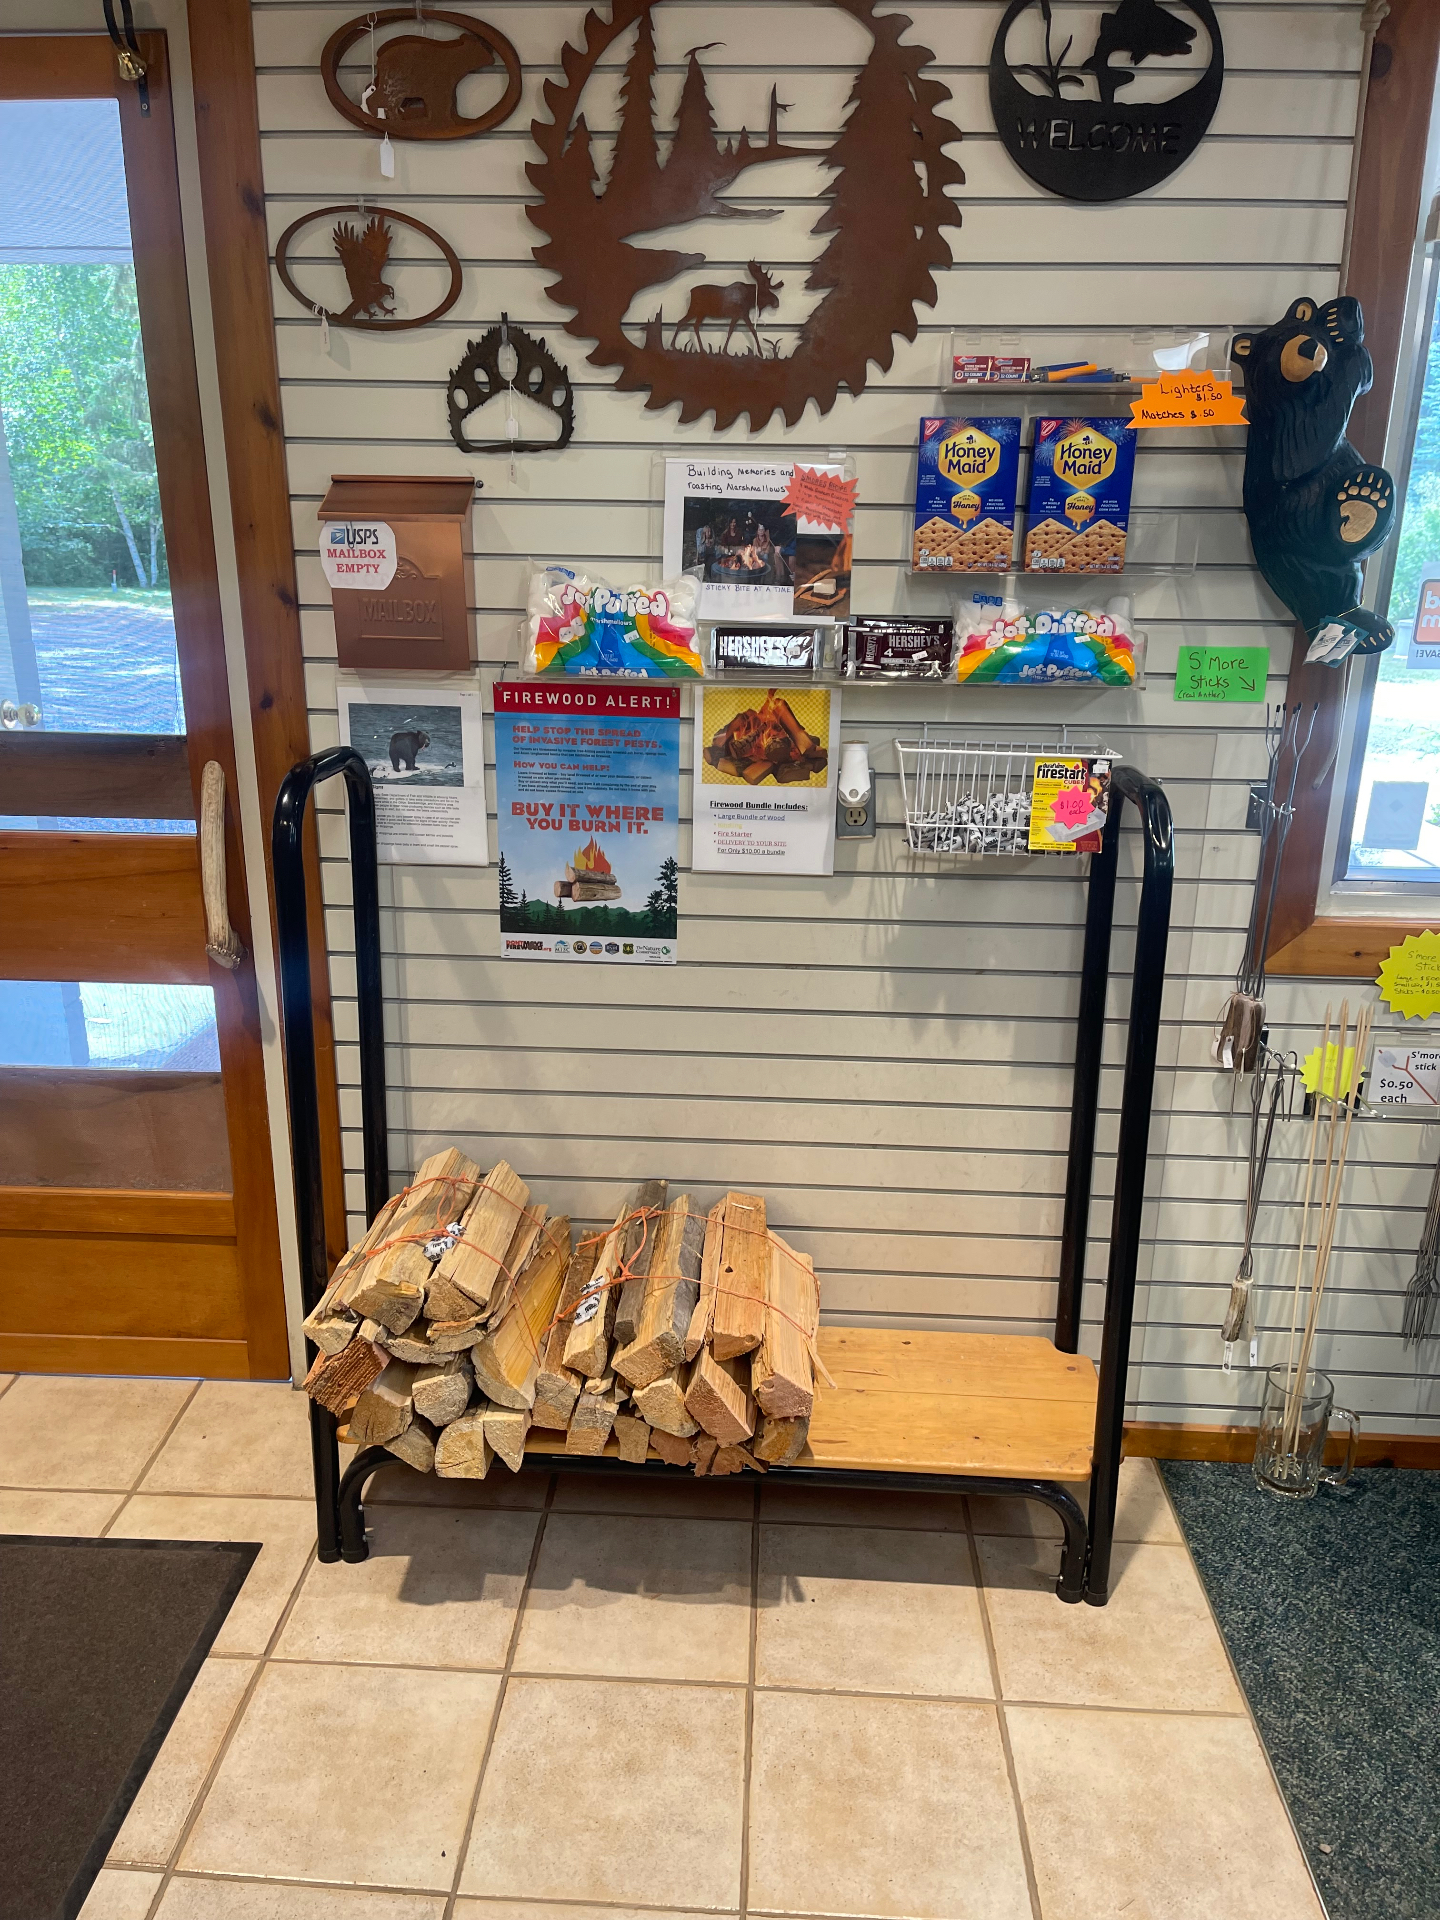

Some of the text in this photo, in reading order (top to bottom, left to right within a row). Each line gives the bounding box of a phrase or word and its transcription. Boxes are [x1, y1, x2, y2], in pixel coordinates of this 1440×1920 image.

[1015, 117, 1183, 154] WELCOME
[1160, 383, 1214, 398] Lighters
[1196, 393, 1223, 402] $1.50
[1141, 409, 1185, 420] Matches
[944, 441, 996, 466] Honey
[1060, 442, 1113, 465] Honey
[686, 464, 733, 479] Building
[780, 469, 794, 477] and
[946, 459, 987, 475] Maid
[1062, 460, 1103, 477] Maid
[687, 482, 723, 493] roasting
[952, 500, 980, 512] Honey
[1066, 502, 1095, 514] Honey
[346, 528, 379, 545] USPS
[327, 548, 387, 559] MAILBOX
[336, 563, 380, 574] EMPTY
[735, 584, 751, 592] BITE
[363, 599, 437, 624] MAILBOX
[888, 634, 940, 648] HERSHEY'S
[883, 647, 894, 657] 4
[1188, 650, 1249, 671] S'More
[1190, 674, 1230, 690] Sticks
[503, 691, 671, 709] FIREWOOD ALERT!
[512, 725, 641, 737] HELP STOP THE SPREAD
[512, 736, 663, 749] OF INVASIVE FOREST PESTS.
[539, 762, 558, 770] YOU
[560, 763, 580, 771] CAN
[1036, 764, 1087, 780] firestart
[710, 800, 808, 811] Firewood Bundle Includes:
[1060, 799, 1084, 810] $1.00
[511, 801, 664, 822] BUY IT WHERE
[526, 817, 649, 835] YOU BURN IT.
[1407, 950, 1437, 962] S'more
[1415, 1063, 1437, 1071] stick
[1379, 1078, 1414, 1090] $0.50
[1380, 1093, 1407, 1104] each
